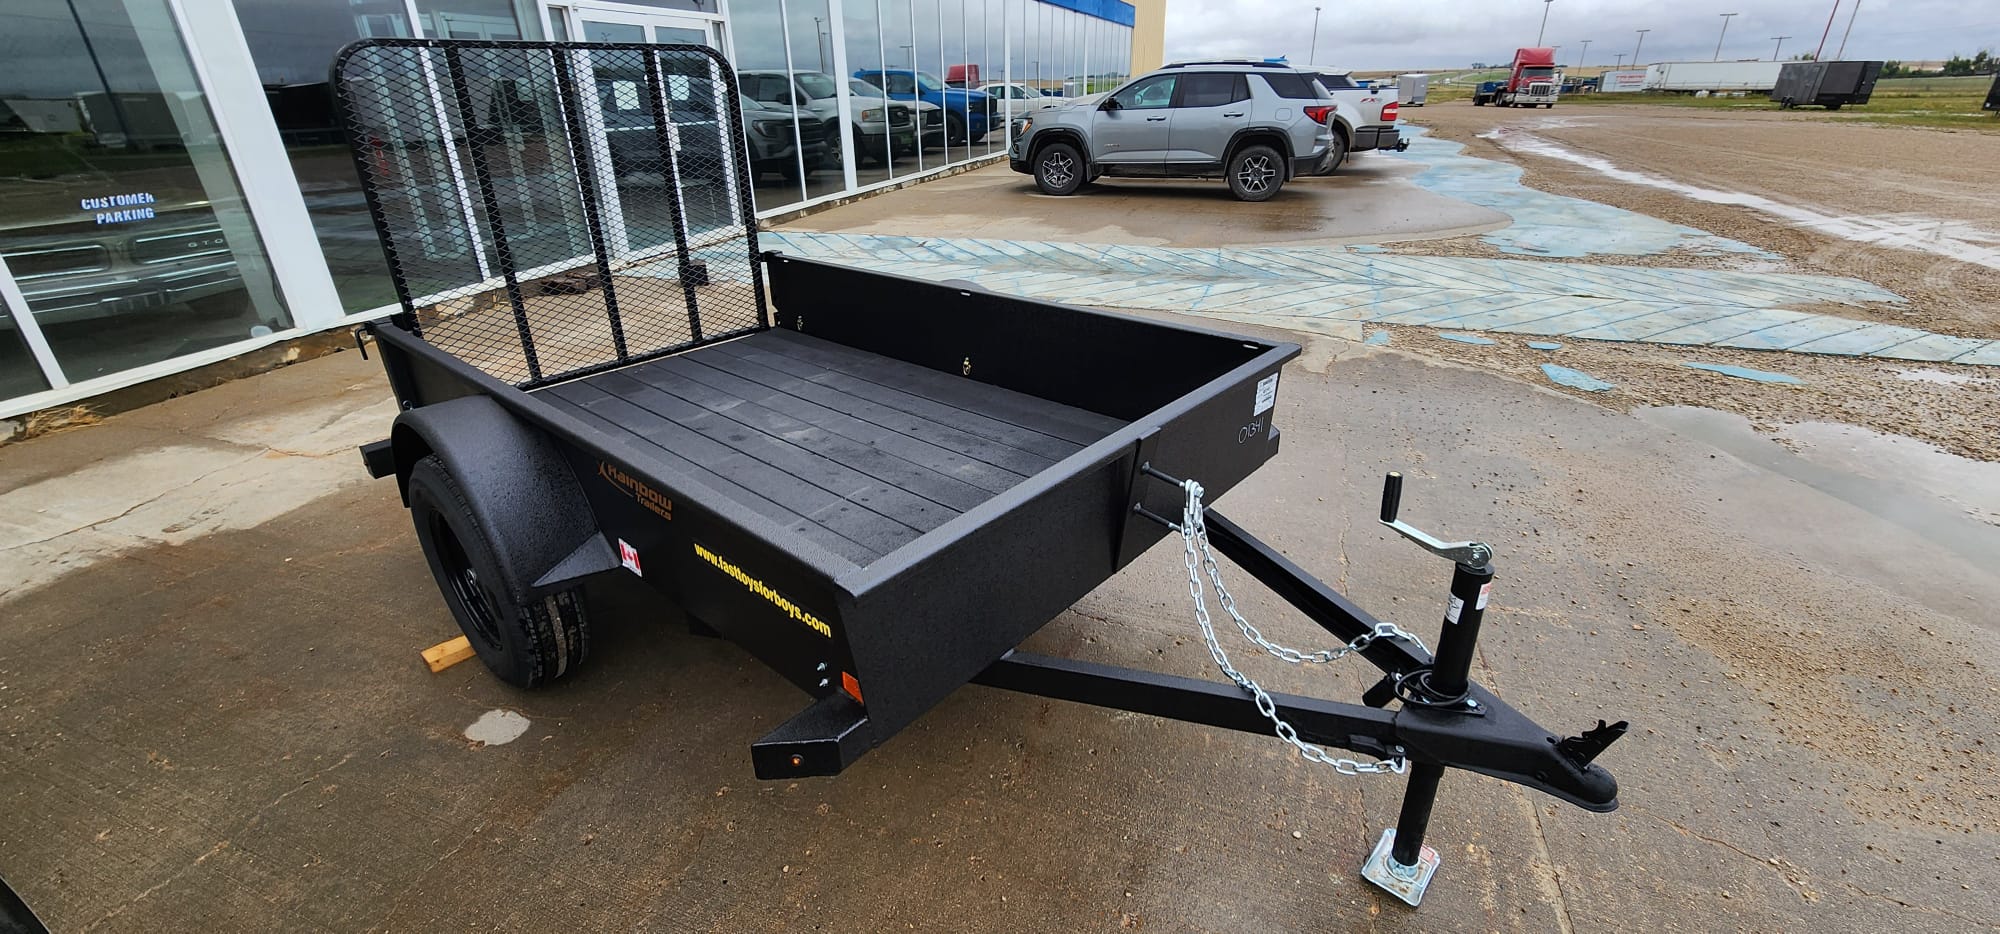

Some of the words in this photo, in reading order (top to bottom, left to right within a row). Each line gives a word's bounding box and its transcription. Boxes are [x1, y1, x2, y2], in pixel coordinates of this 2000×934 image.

[81, 192, 155, 210] CUSTOMER
[96, 207, 155, 225] PARKING
[188, 238, 224, 248] GTO
[607, 463, 673, 512] Rainbow
[636, 492, 672, 521] Trailers
[694, 543, 832, 638] www.fasttoysforboys.com
